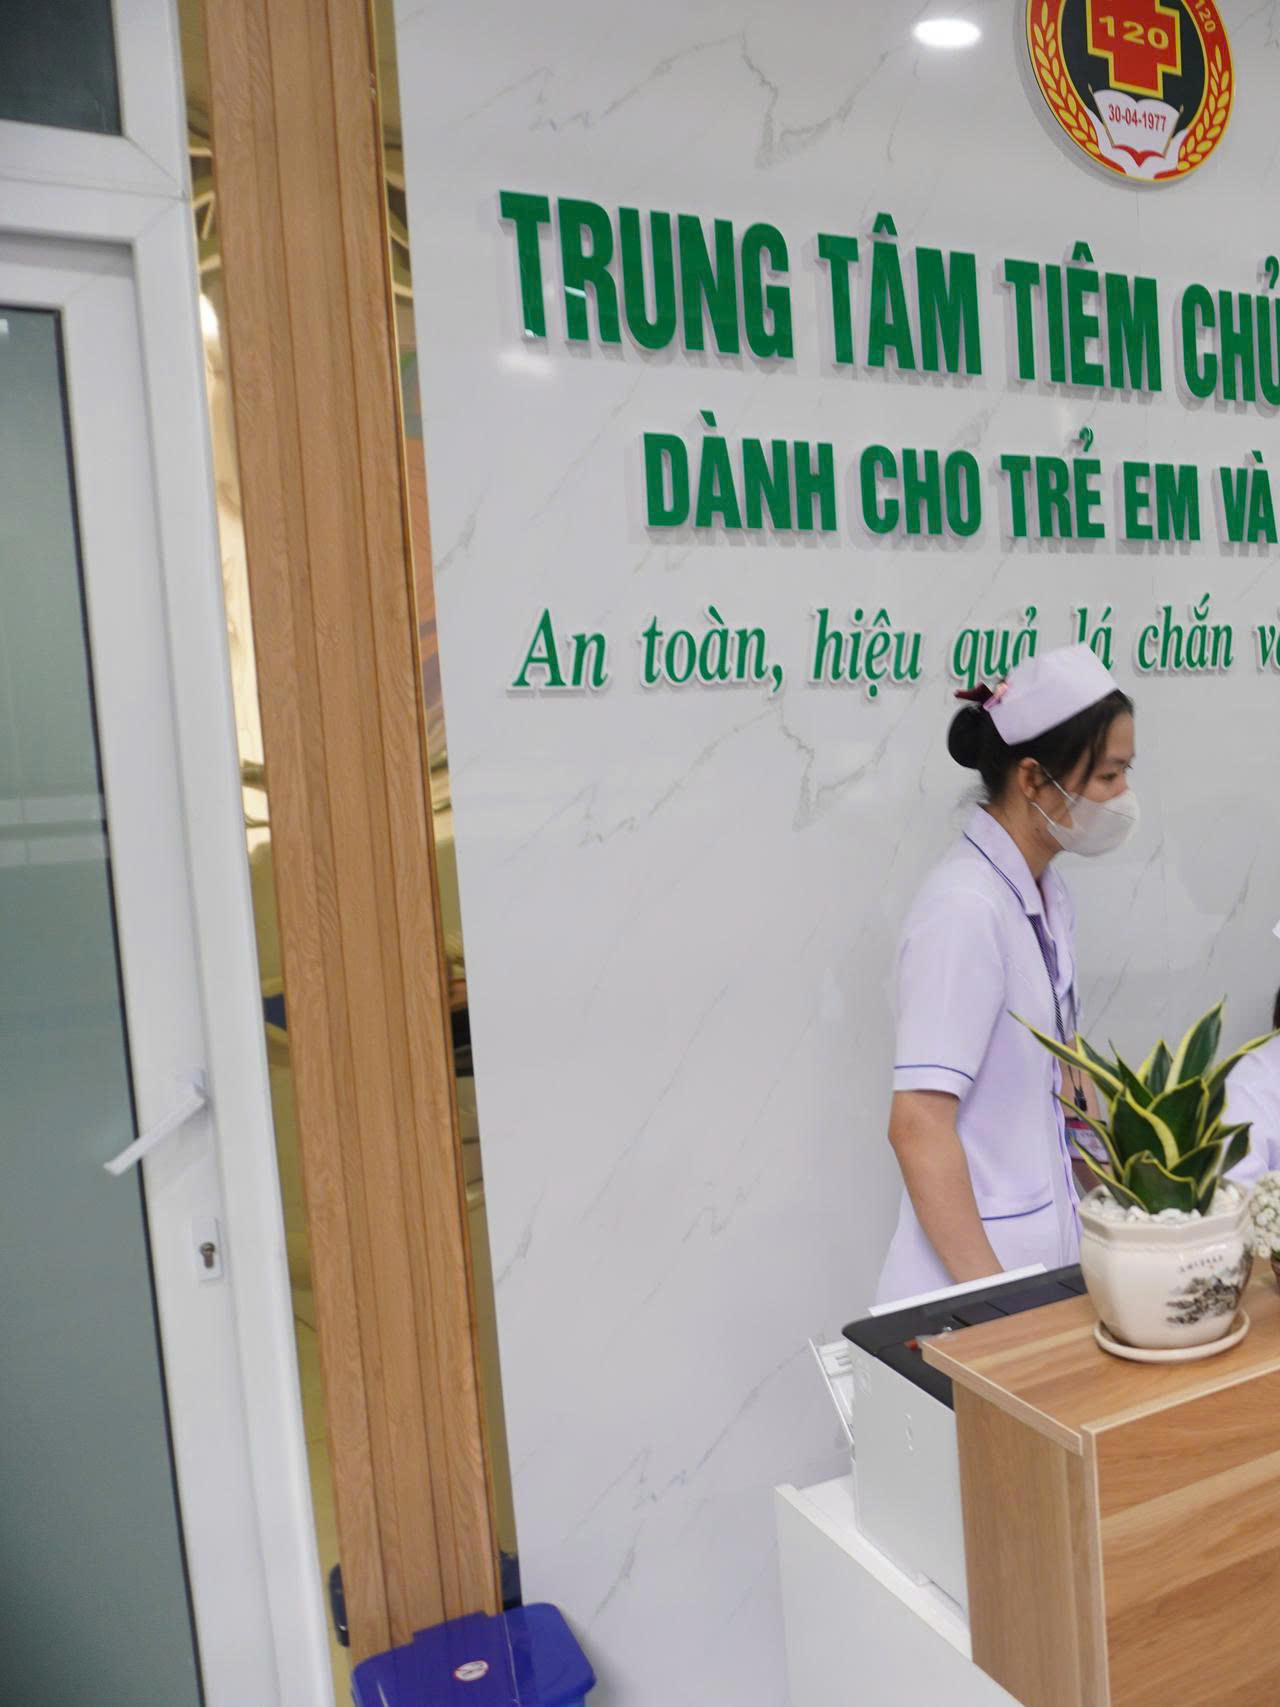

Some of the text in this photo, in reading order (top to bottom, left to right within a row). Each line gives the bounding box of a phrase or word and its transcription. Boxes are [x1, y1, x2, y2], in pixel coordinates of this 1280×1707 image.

[1098, 15, 1170, 50] 120
[1107, 103, 1167, 133] 30-04-1977
[499, 189, 795, 360] TRUNG
[816, 212, 983, 377] TÂM
[1003, 239, 1163, 393] TIÊM
[642, 408, 838, 533] DÀNH
[858, 443, 982, 538] CHO
[1000, 426, 1105, 540] TRẺ
[1121, 460, 1201, 543] EM
[1219, 450, 1279, 545] VÀ
[511, 607, 609, 688] An
[642, 604, 783, 693] toàn,
[812, 607, 922, 698] hiệu
[952, 604, 1038, 690] quả
[1138, 593, 1233, 670] chắn
